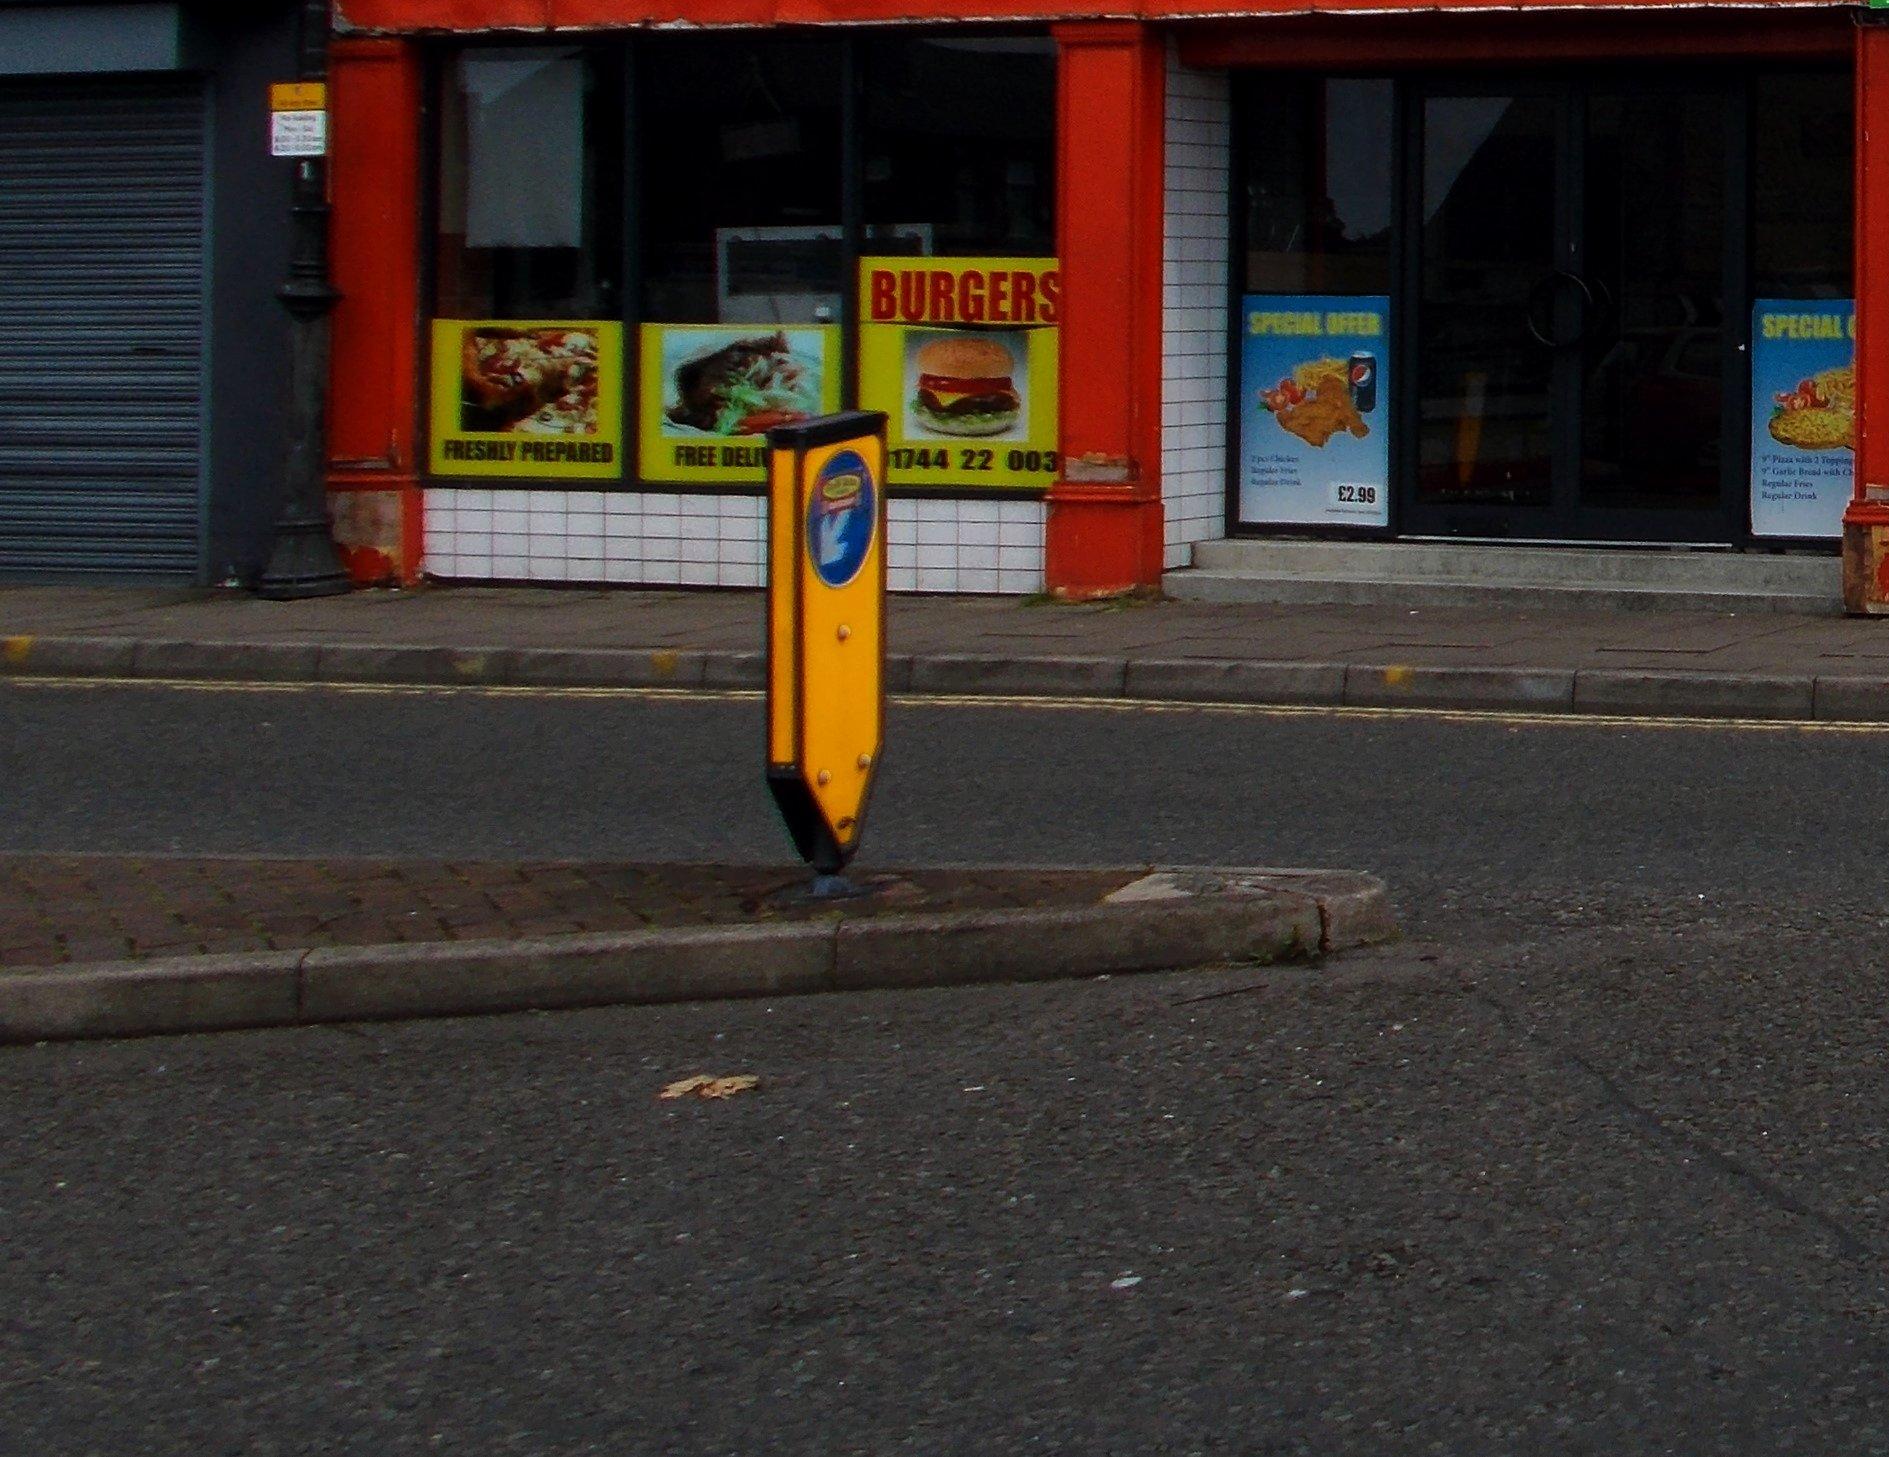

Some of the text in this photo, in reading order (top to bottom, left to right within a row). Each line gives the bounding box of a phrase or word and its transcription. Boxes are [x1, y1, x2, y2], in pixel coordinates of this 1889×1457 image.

[871, 270, 1059, 323] BURGERS
[1761, 314, 1842, 340] SPECIAL
[444, 441, 615, 464] FRESHLY PREPARED
[674, 444, 717, 467] FREE
[961, 448, 992, 471] 22
[1009, 449, 1058, 473] 003
[1338, 486, 1376, 504] £2.99
